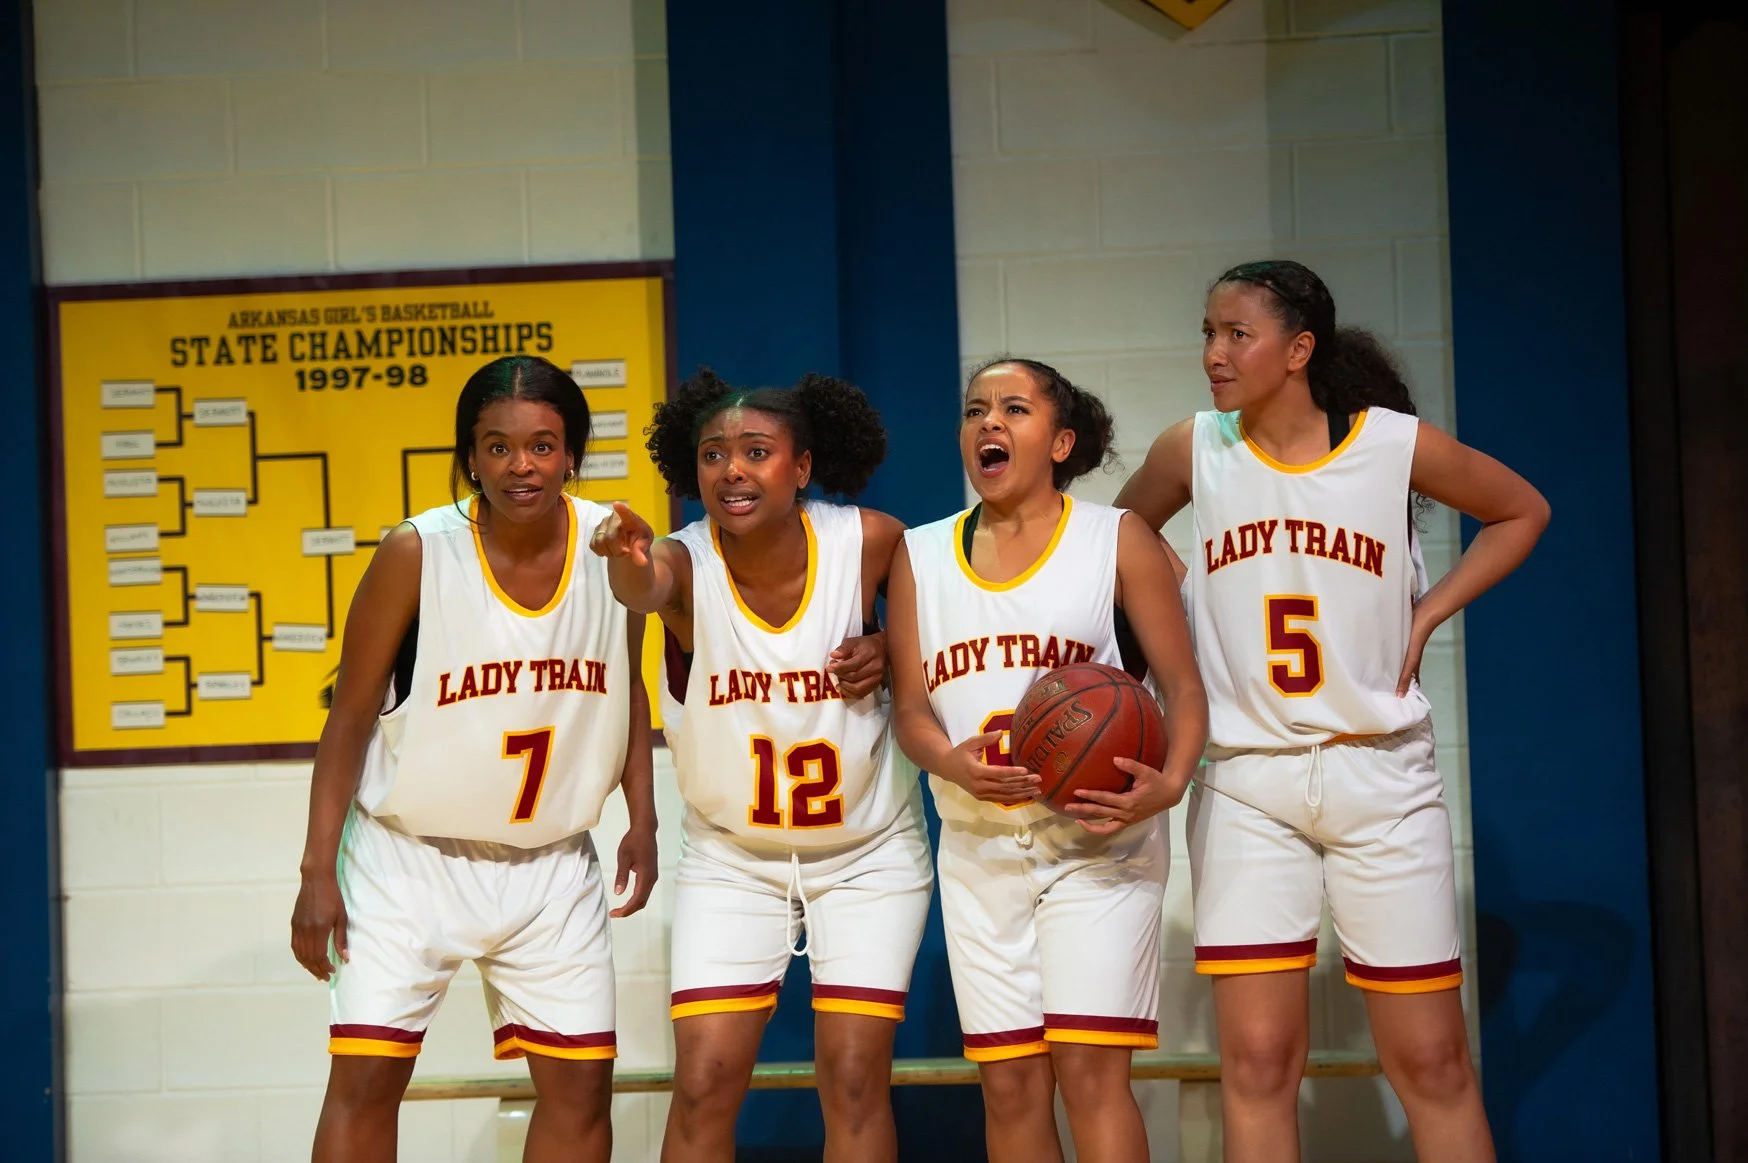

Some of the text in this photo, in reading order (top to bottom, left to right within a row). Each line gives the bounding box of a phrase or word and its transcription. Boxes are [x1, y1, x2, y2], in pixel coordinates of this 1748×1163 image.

[170, 322, 553, 367] STATE CHAMPIONSHIPS
[227, 301, 494, 329] ARKANSAS GIRL'S BASKETBALL
[295, 364, 428, 391] 1997-98
[1204, 519, 1386, 579] LADY TRAIN
[923, 636, 990, 694] LADY
[996, 633, 1096, 669] TRAIN
[1264, 593, 1325, 698] 5
[437, 658, 608, 708] LADY TRAIN
[709, 668, 847, 707] LADY TRA
[1024, 700, 1093, 775] SPALDIN
[501, 725, 556, 824] 7
[748, 734, 844, 830] 12
